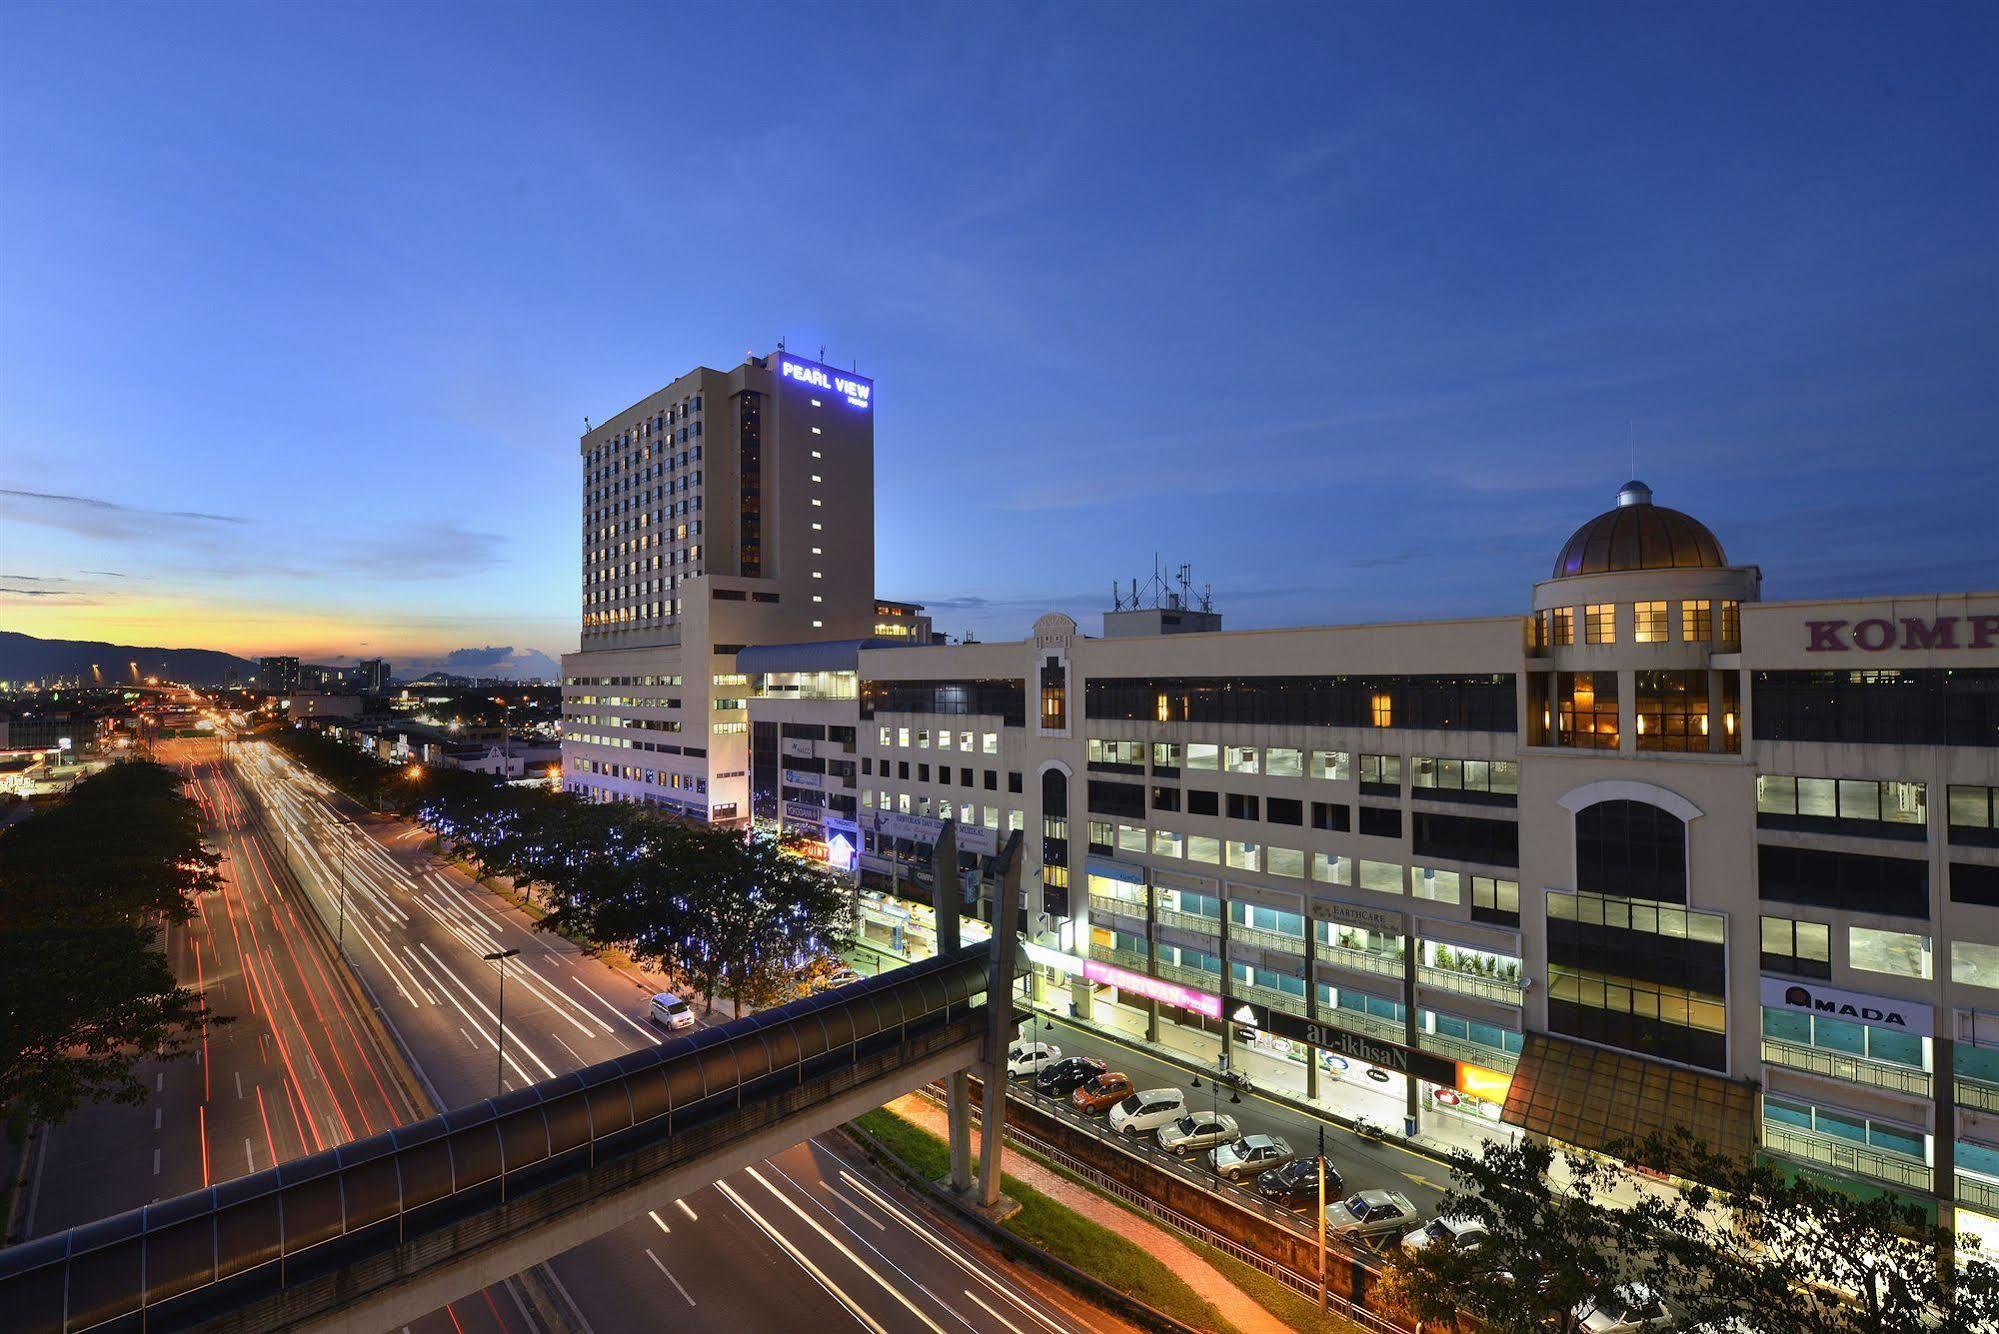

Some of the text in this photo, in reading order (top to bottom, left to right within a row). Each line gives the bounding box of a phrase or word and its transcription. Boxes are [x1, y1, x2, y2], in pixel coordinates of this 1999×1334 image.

[783, 361, 869, 399] PEARL VIEW
[1785, 986, 1906, 1026] AMADA
